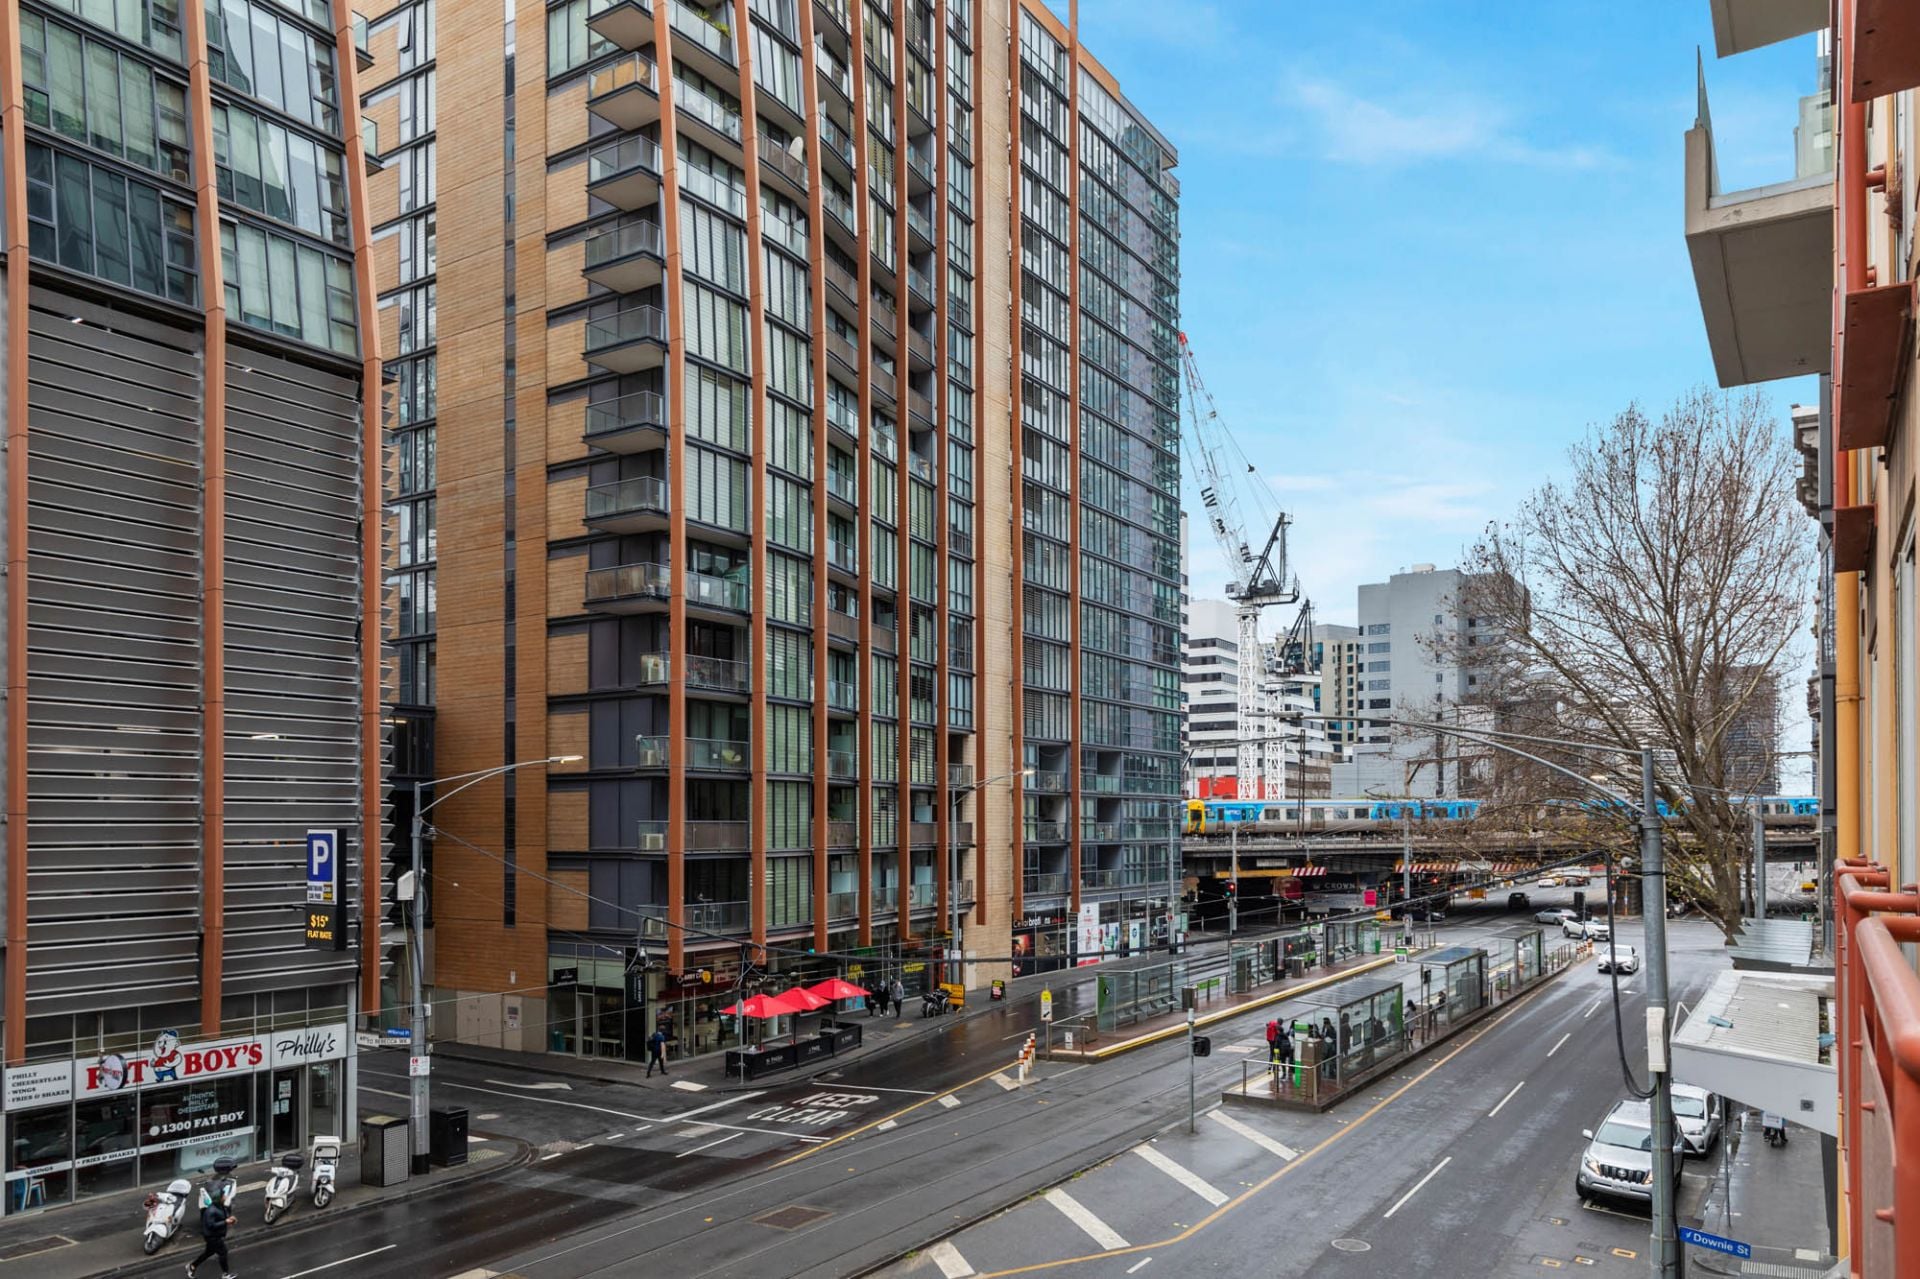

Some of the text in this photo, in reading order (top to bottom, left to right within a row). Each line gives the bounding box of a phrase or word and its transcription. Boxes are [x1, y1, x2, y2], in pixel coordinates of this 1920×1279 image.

[312, 840, 329, 876] P
[307, 930, 319, 939] FLAT
[276, 1032, 337, 1059] Philly's
[12, 1072, 37, 1080] PHILLY
[86, 1059, 149, 1090] FT
[183, 1043, 263, 1076] BOY'S
[792, 1092, 880, 1108] KEEP
[161, 1110, 245, 1134] 1300 FAT BOY
[747, 1106, 848, 1125] CLEAR
[1693, 1233, 1749, 1256] Downie St
